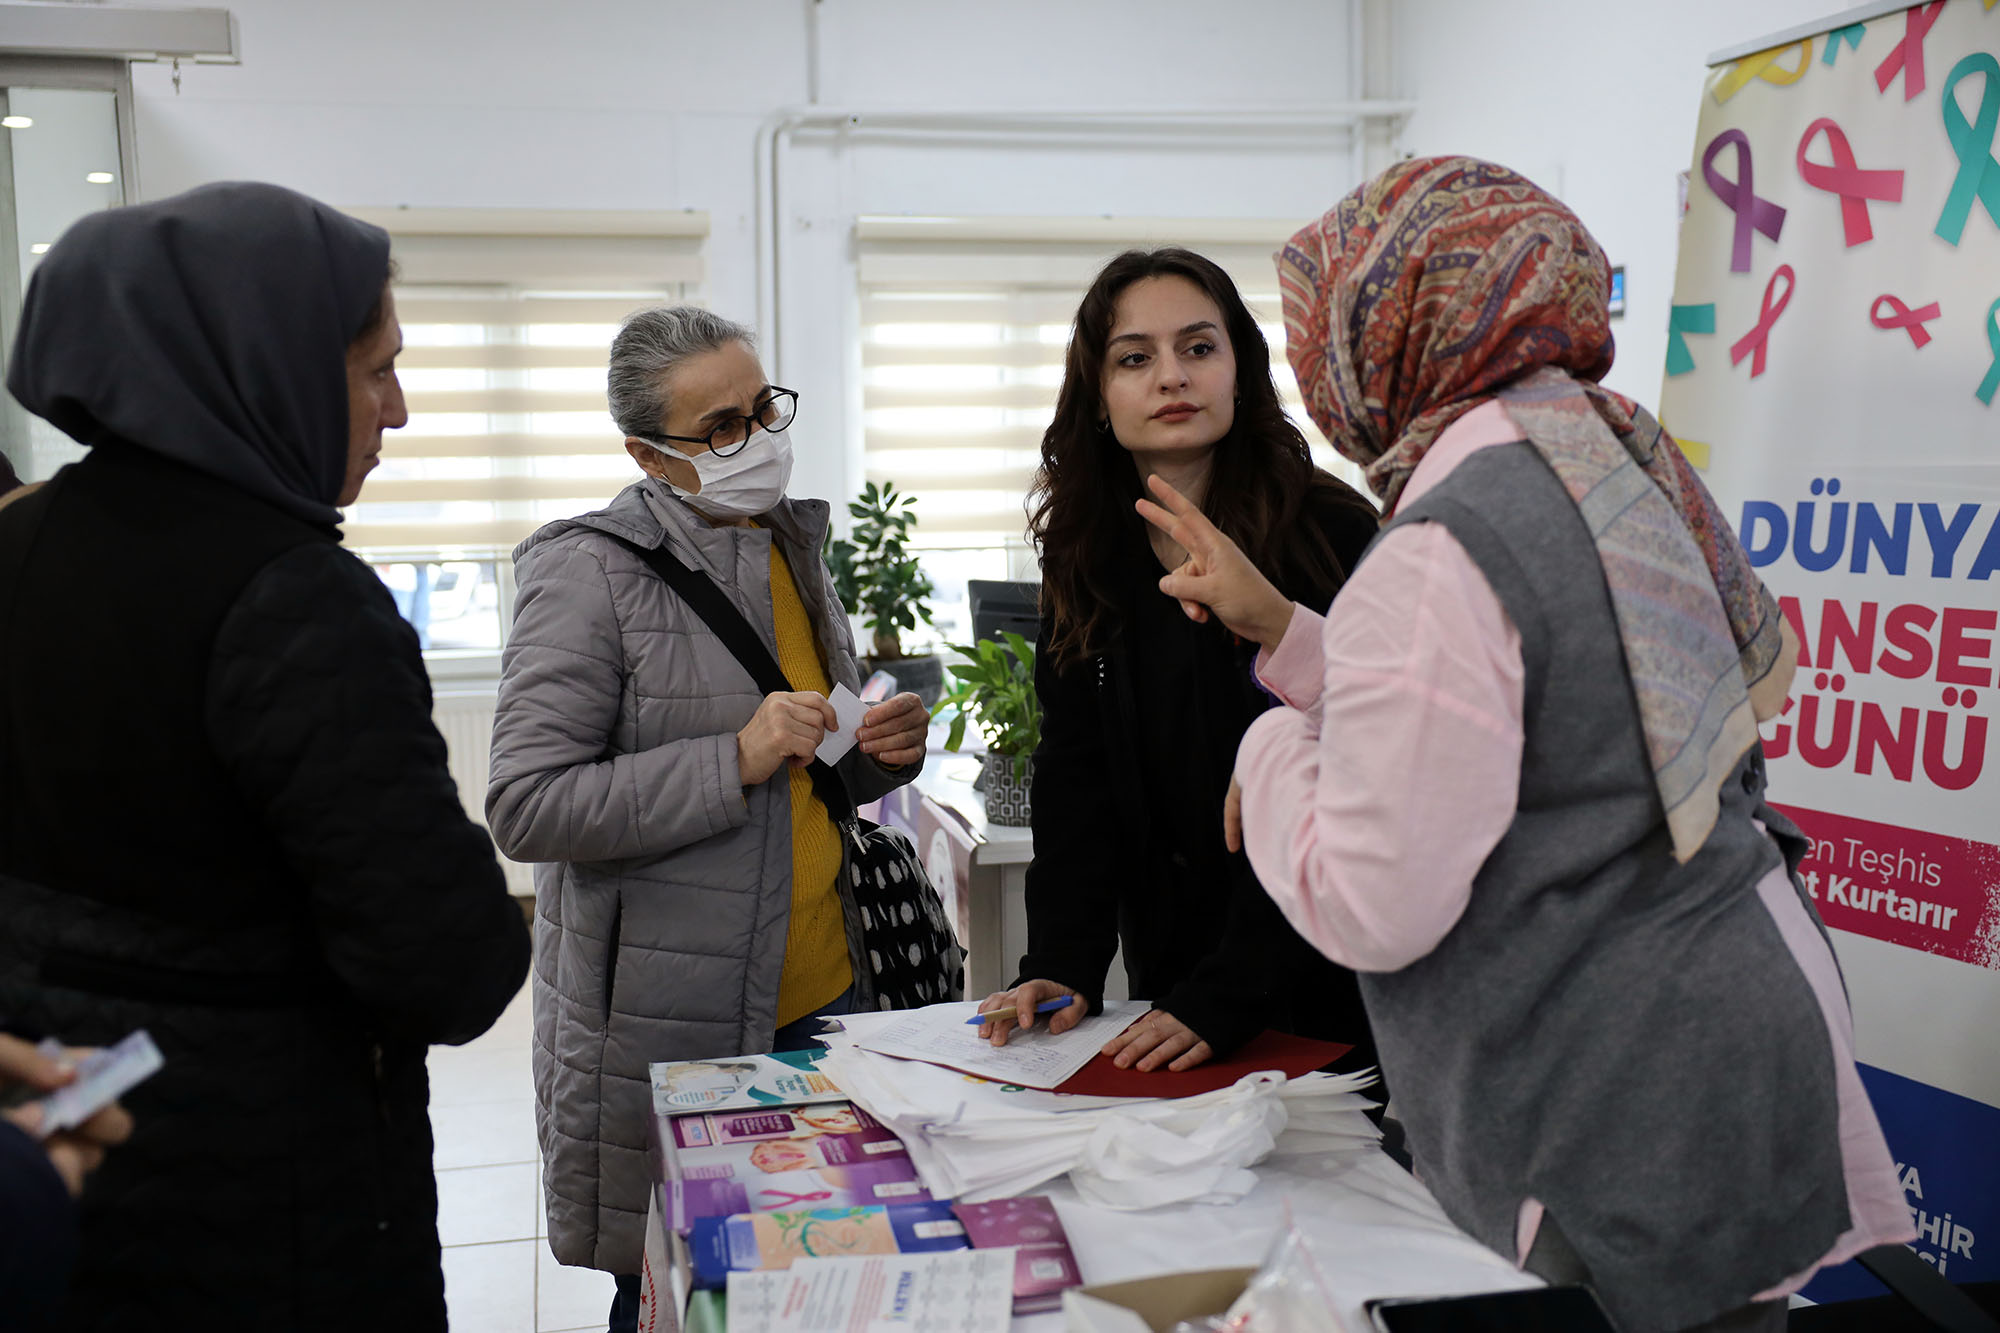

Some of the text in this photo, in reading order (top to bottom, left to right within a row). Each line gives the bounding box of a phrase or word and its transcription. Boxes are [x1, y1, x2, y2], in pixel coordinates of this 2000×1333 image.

[1777, 595, 2000, 688] ANSE
[1843, 837, 1942, 887] Teşhis
[1827, 873, 1959, 932] Kurtarır
